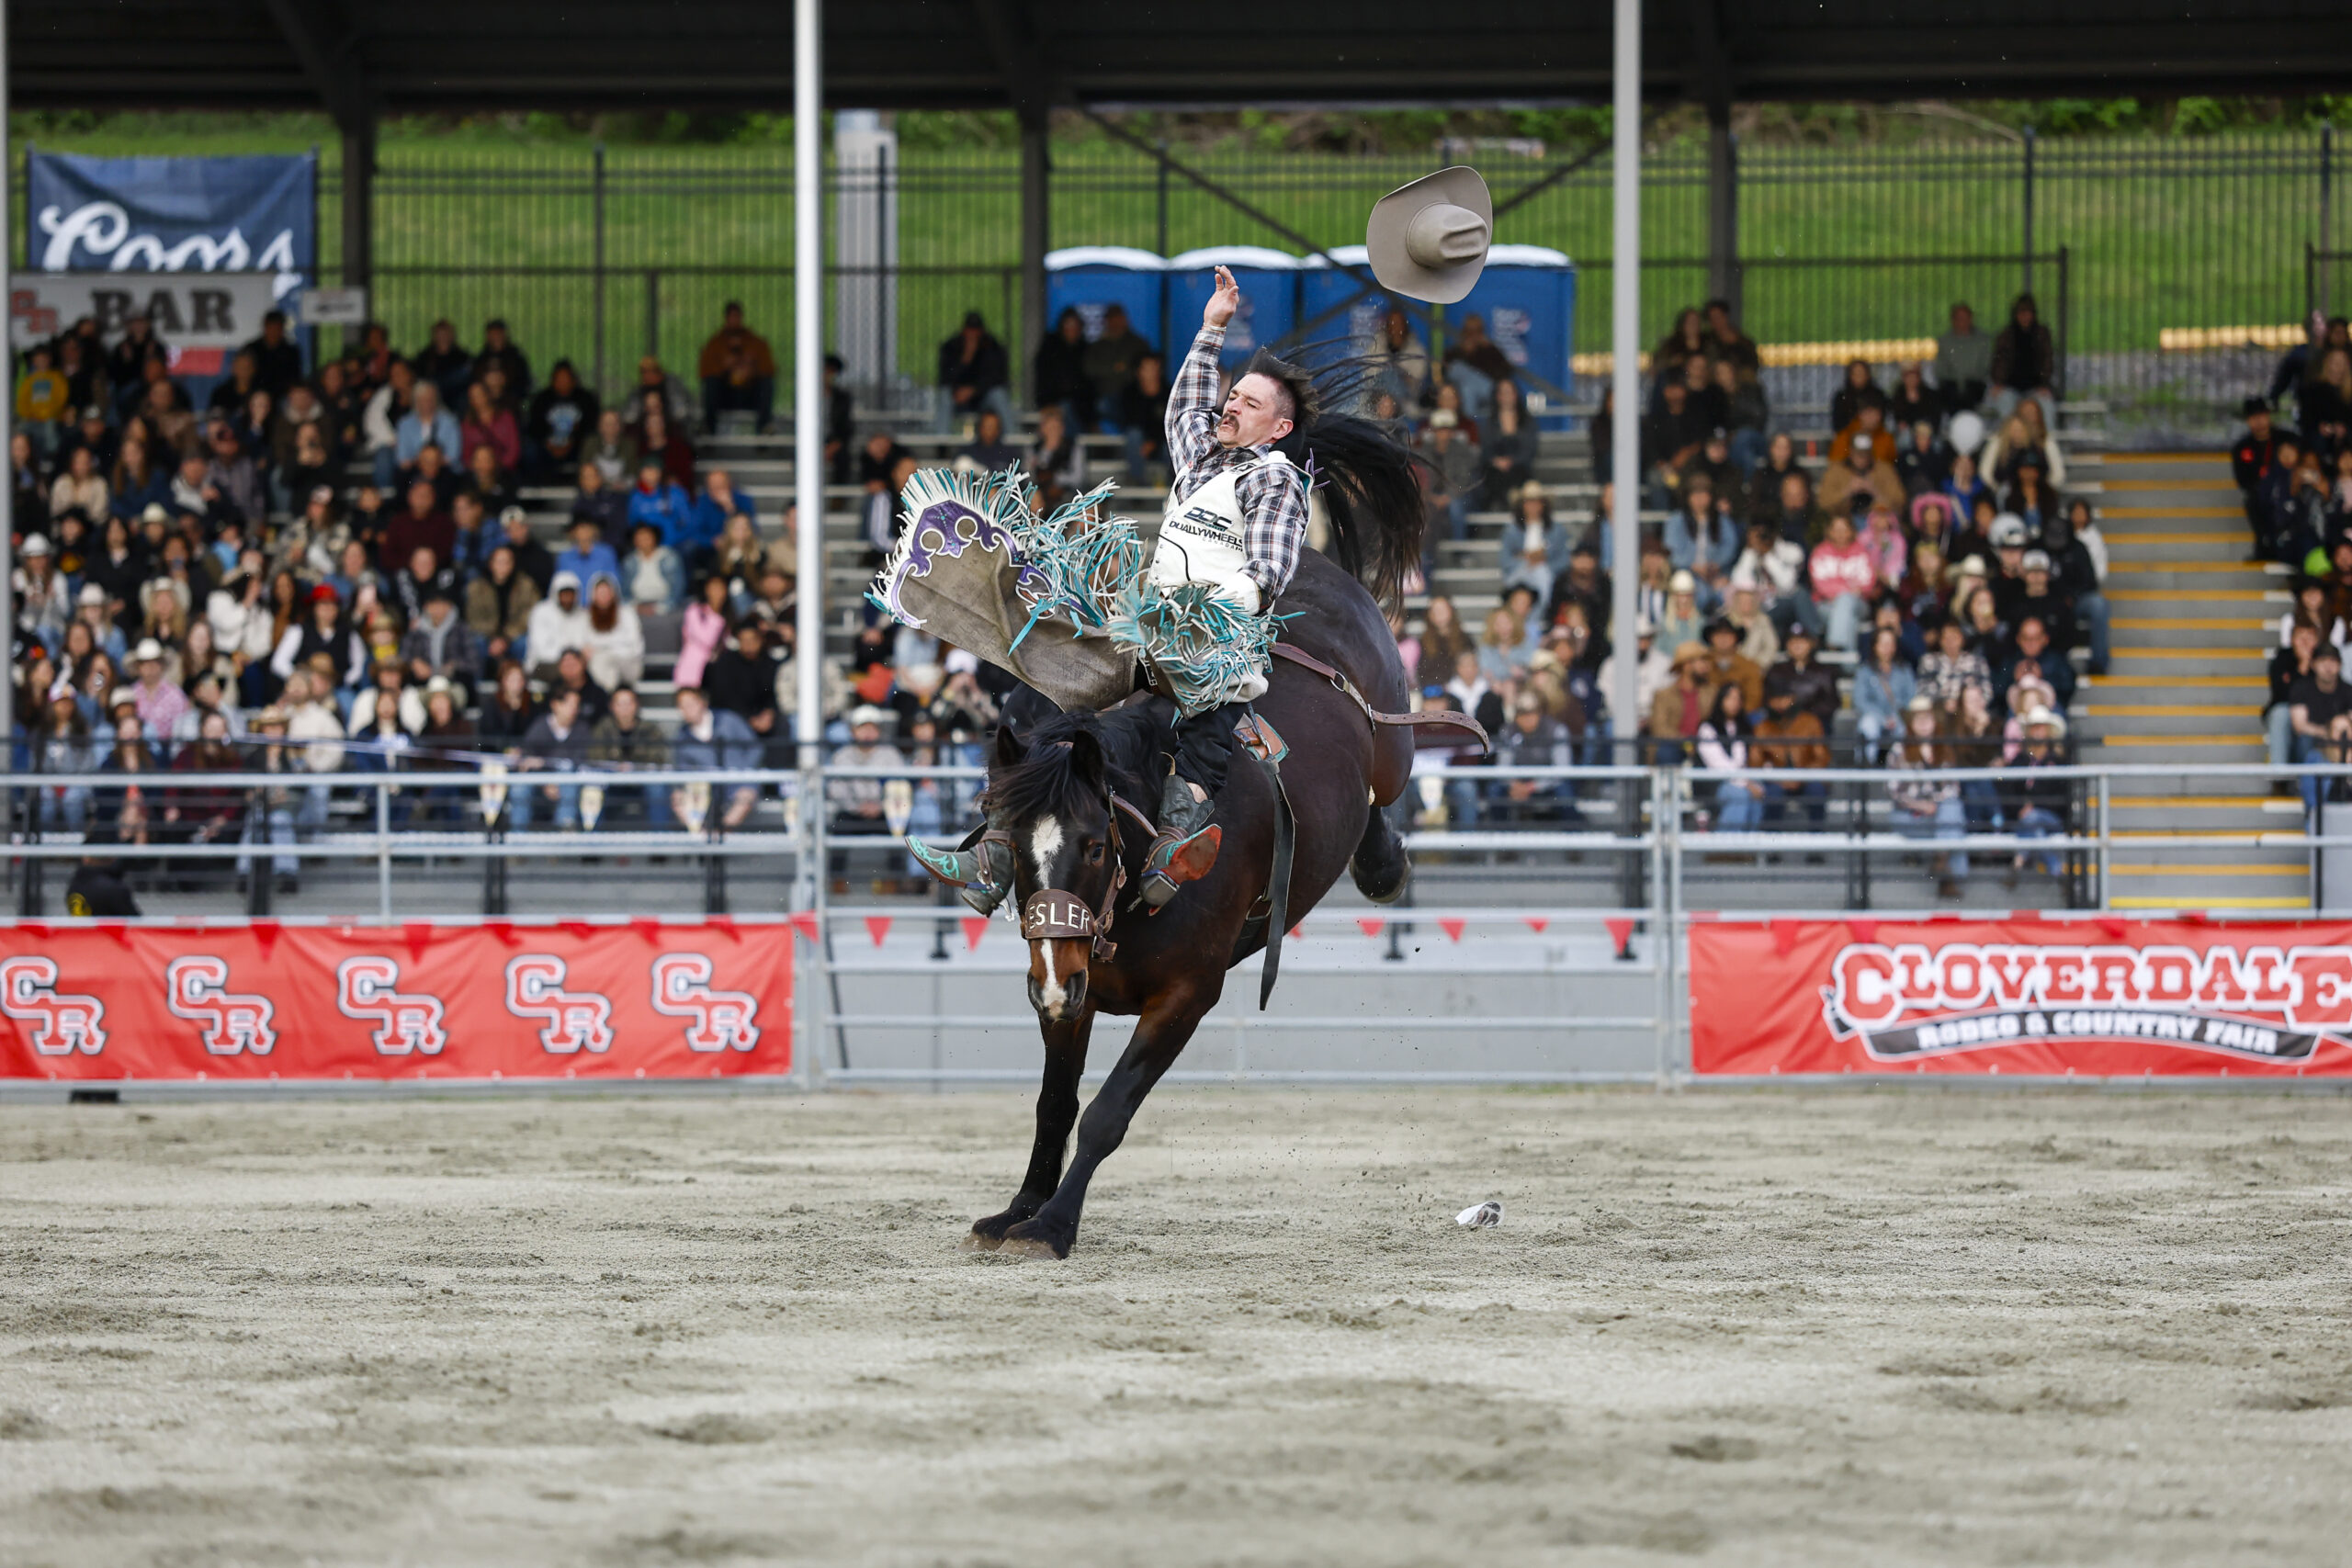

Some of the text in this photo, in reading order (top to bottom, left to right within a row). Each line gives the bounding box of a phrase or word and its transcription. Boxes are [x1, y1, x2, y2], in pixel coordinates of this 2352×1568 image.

[91, 288, 235, 333] BAR
[1, 956, 108, 1055] CR
[166, 955, 278, 1055] CR
[336, 956, 447, 1055] CR
[505, 953, 615, 1054] CR
[650, 953, 762, 1052] CR
[1834, 944, 2352, 1032] CLOVERDALE
[1916, 1013, 2020, 1050] RODEO
[2052, 1010, 2200, 1040] COUNTRY
[2204, 1017, 2278, 1054] FAIR
